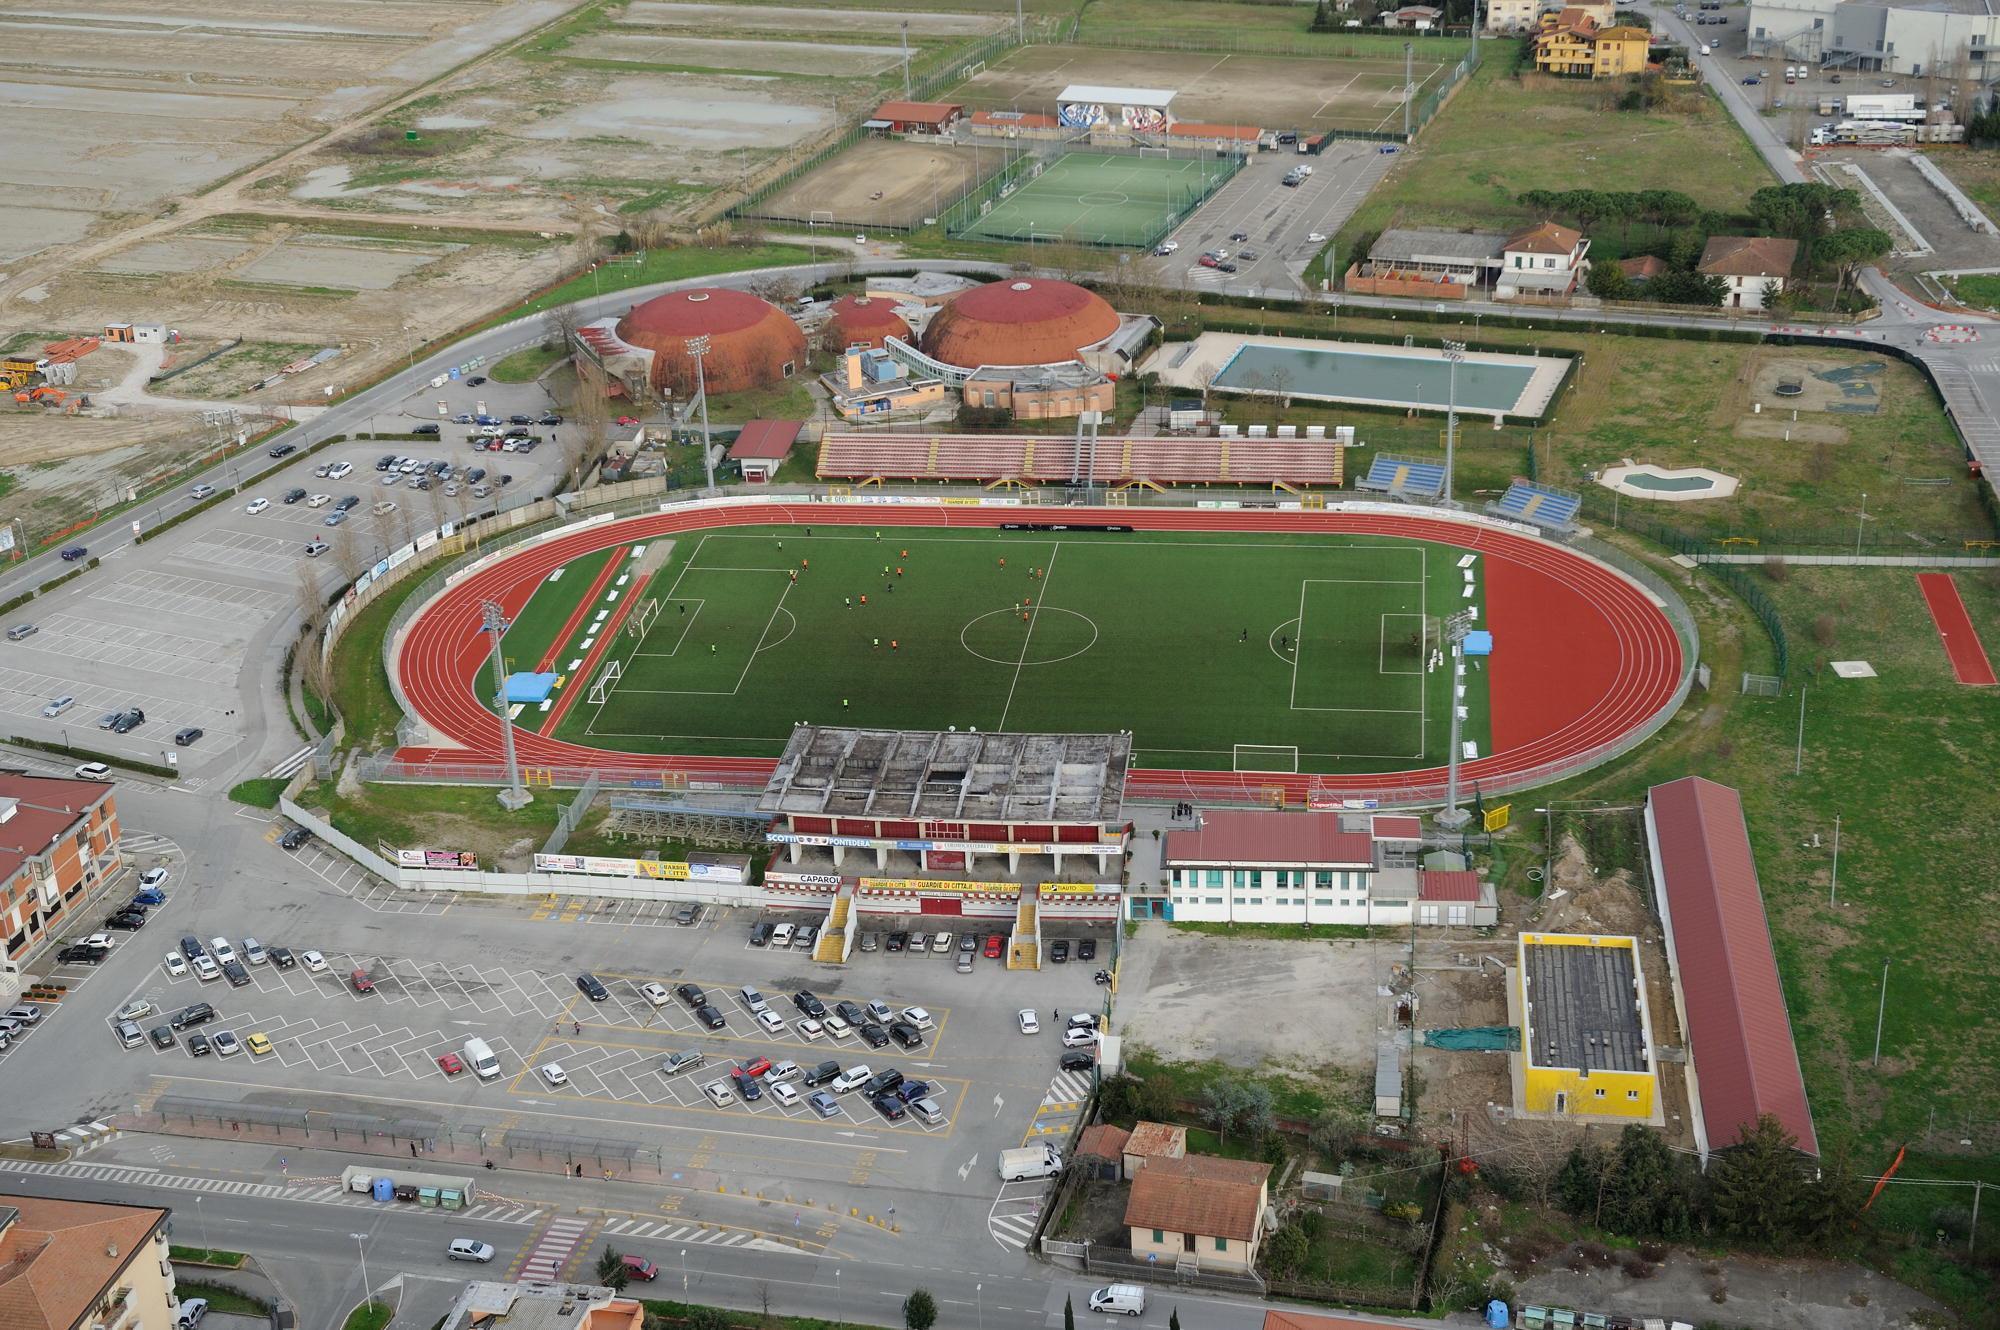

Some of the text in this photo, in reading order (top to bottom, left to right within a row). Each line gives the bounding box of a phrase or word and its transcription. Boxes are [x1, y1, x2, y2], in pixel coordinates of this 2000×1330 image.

[766, 834, 797, 843] SCOTTI
[829, 837, 870, 847] PONTEDERA
[800, 875, 840, 884] CAPAROL
[917, 881, 943, 889] GUARDIE
